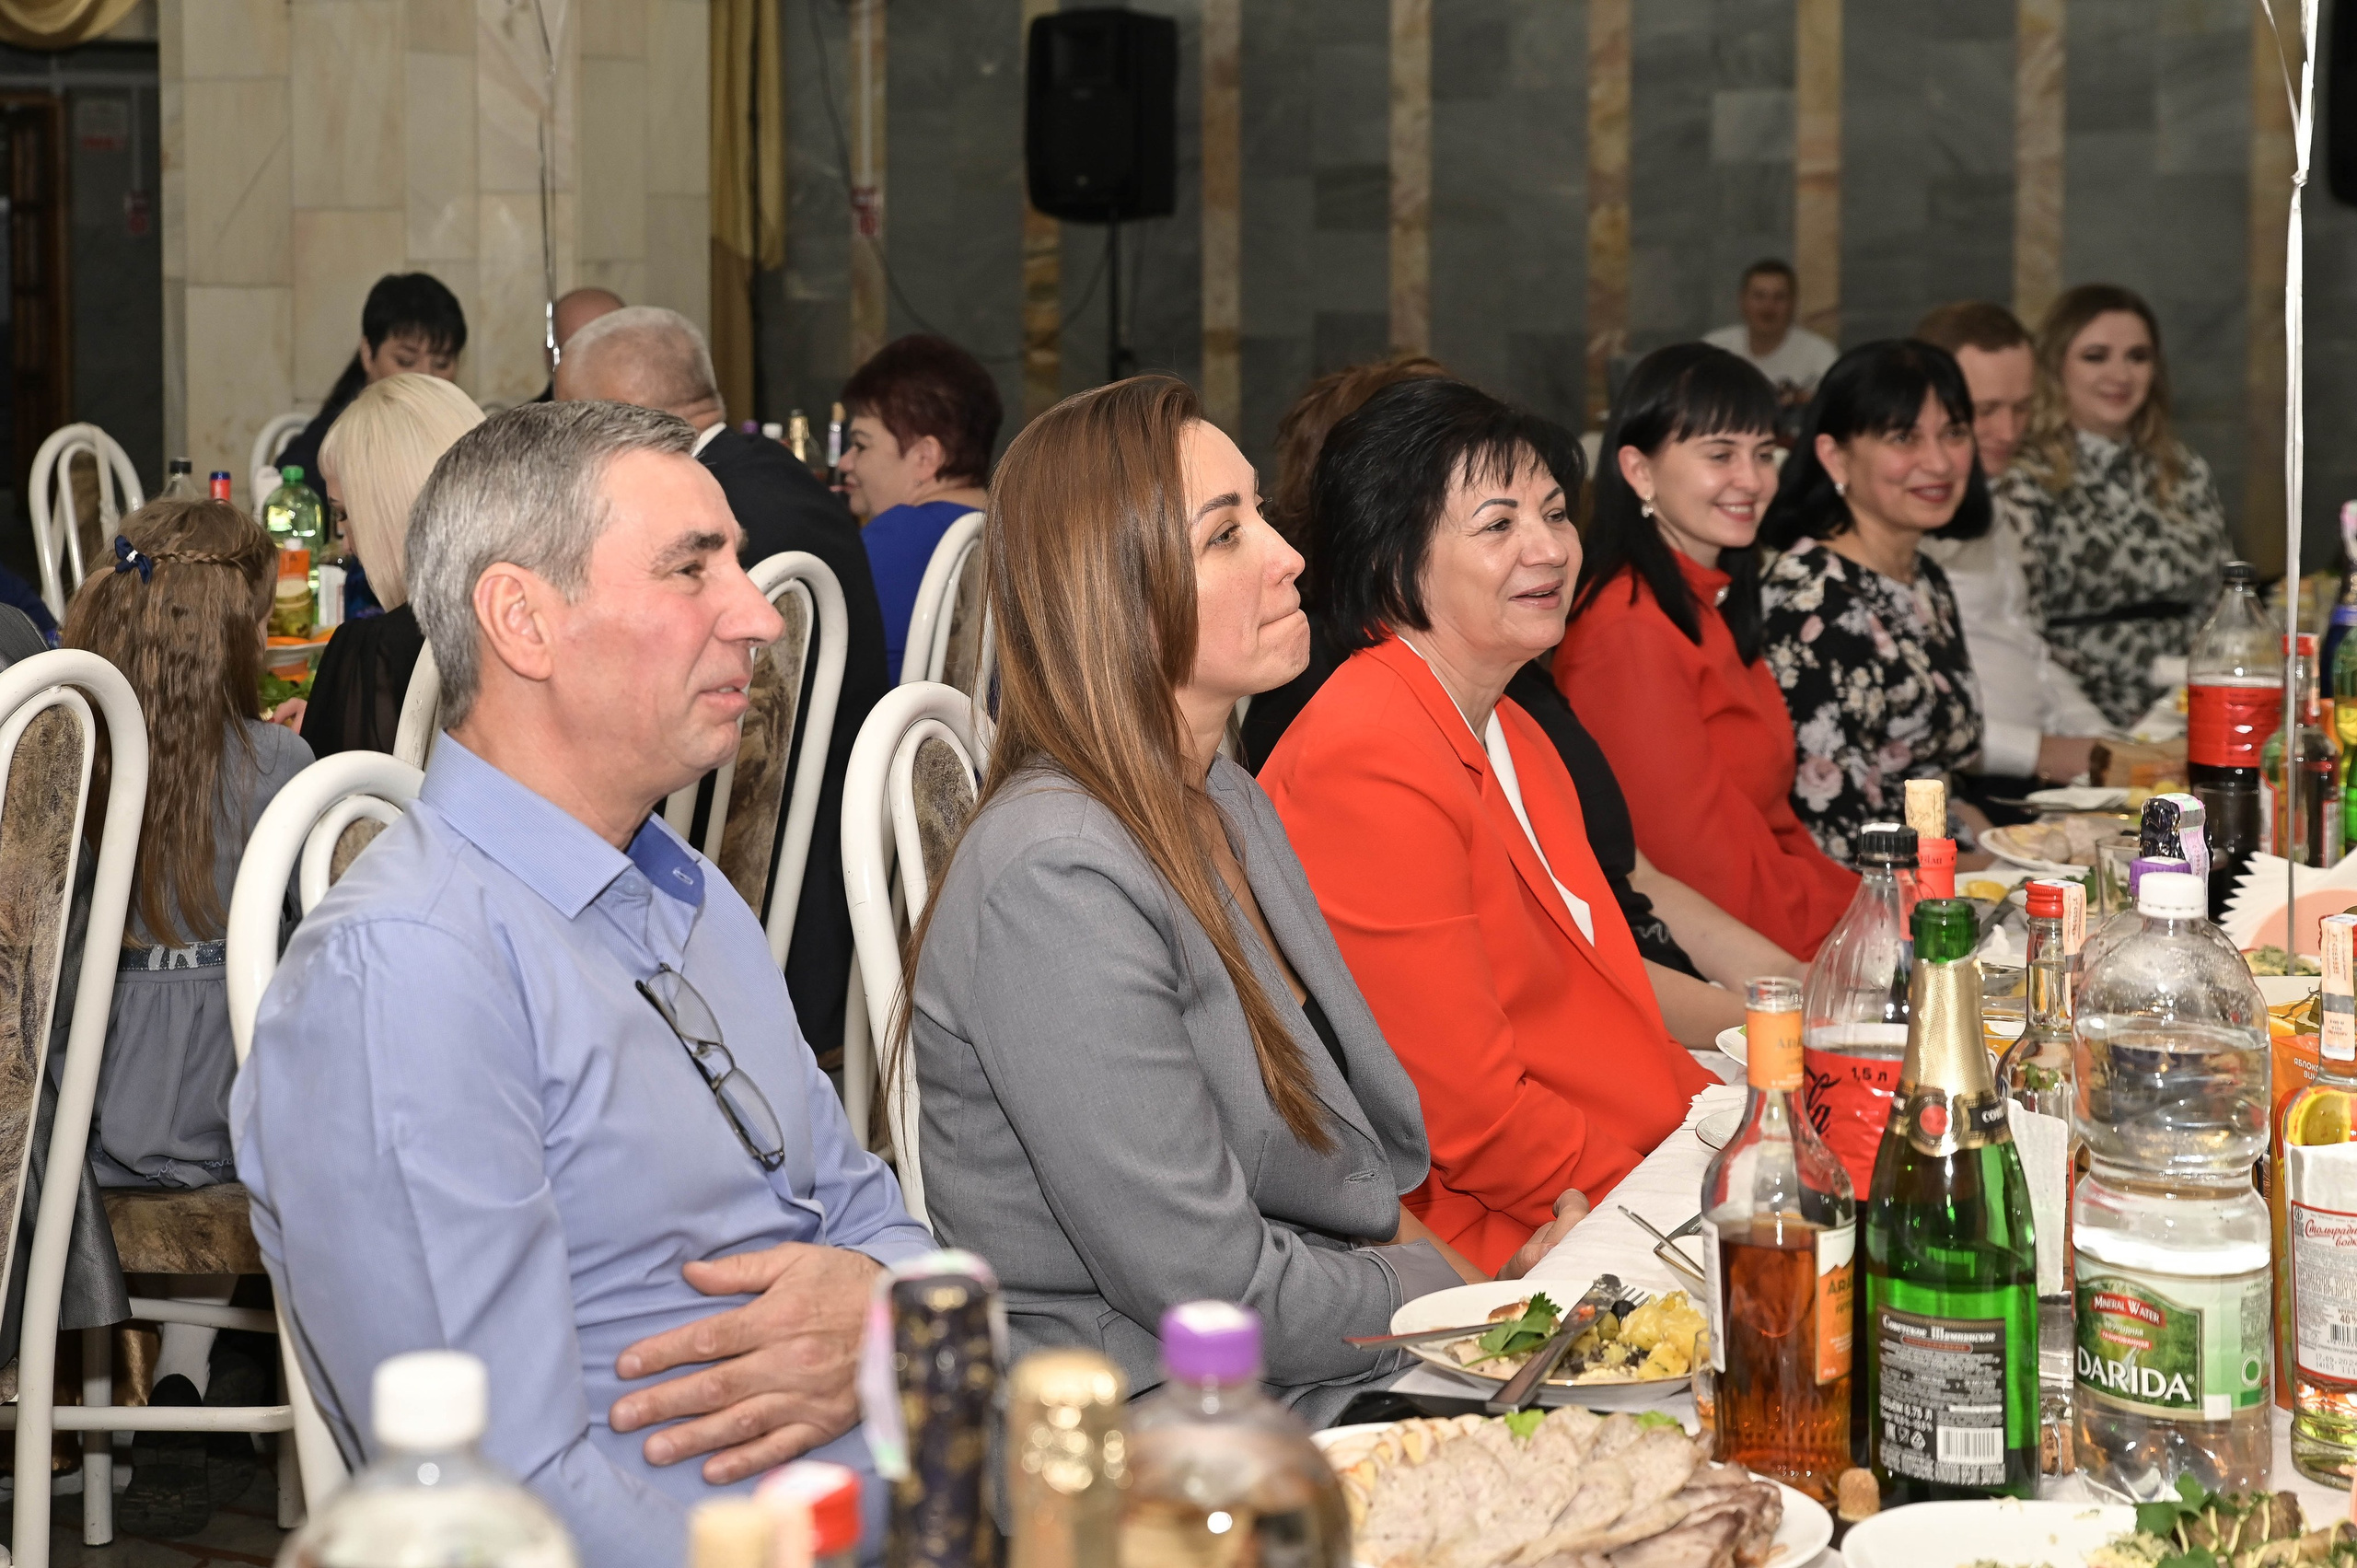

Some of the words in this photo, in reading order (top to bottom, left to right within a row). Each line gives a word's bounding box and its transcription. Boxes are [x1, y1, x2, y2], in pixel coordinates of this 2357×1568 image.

[1851, 1067, 1872, 1082] 1,5
[2094, 1295, 2126, 1311] MINERAL
[2128, 1299, 2160, 1324] WATER
[2340, 1315, 2351, 1324] 40
[2077, 1345, 2193, 1402] DARIDA
